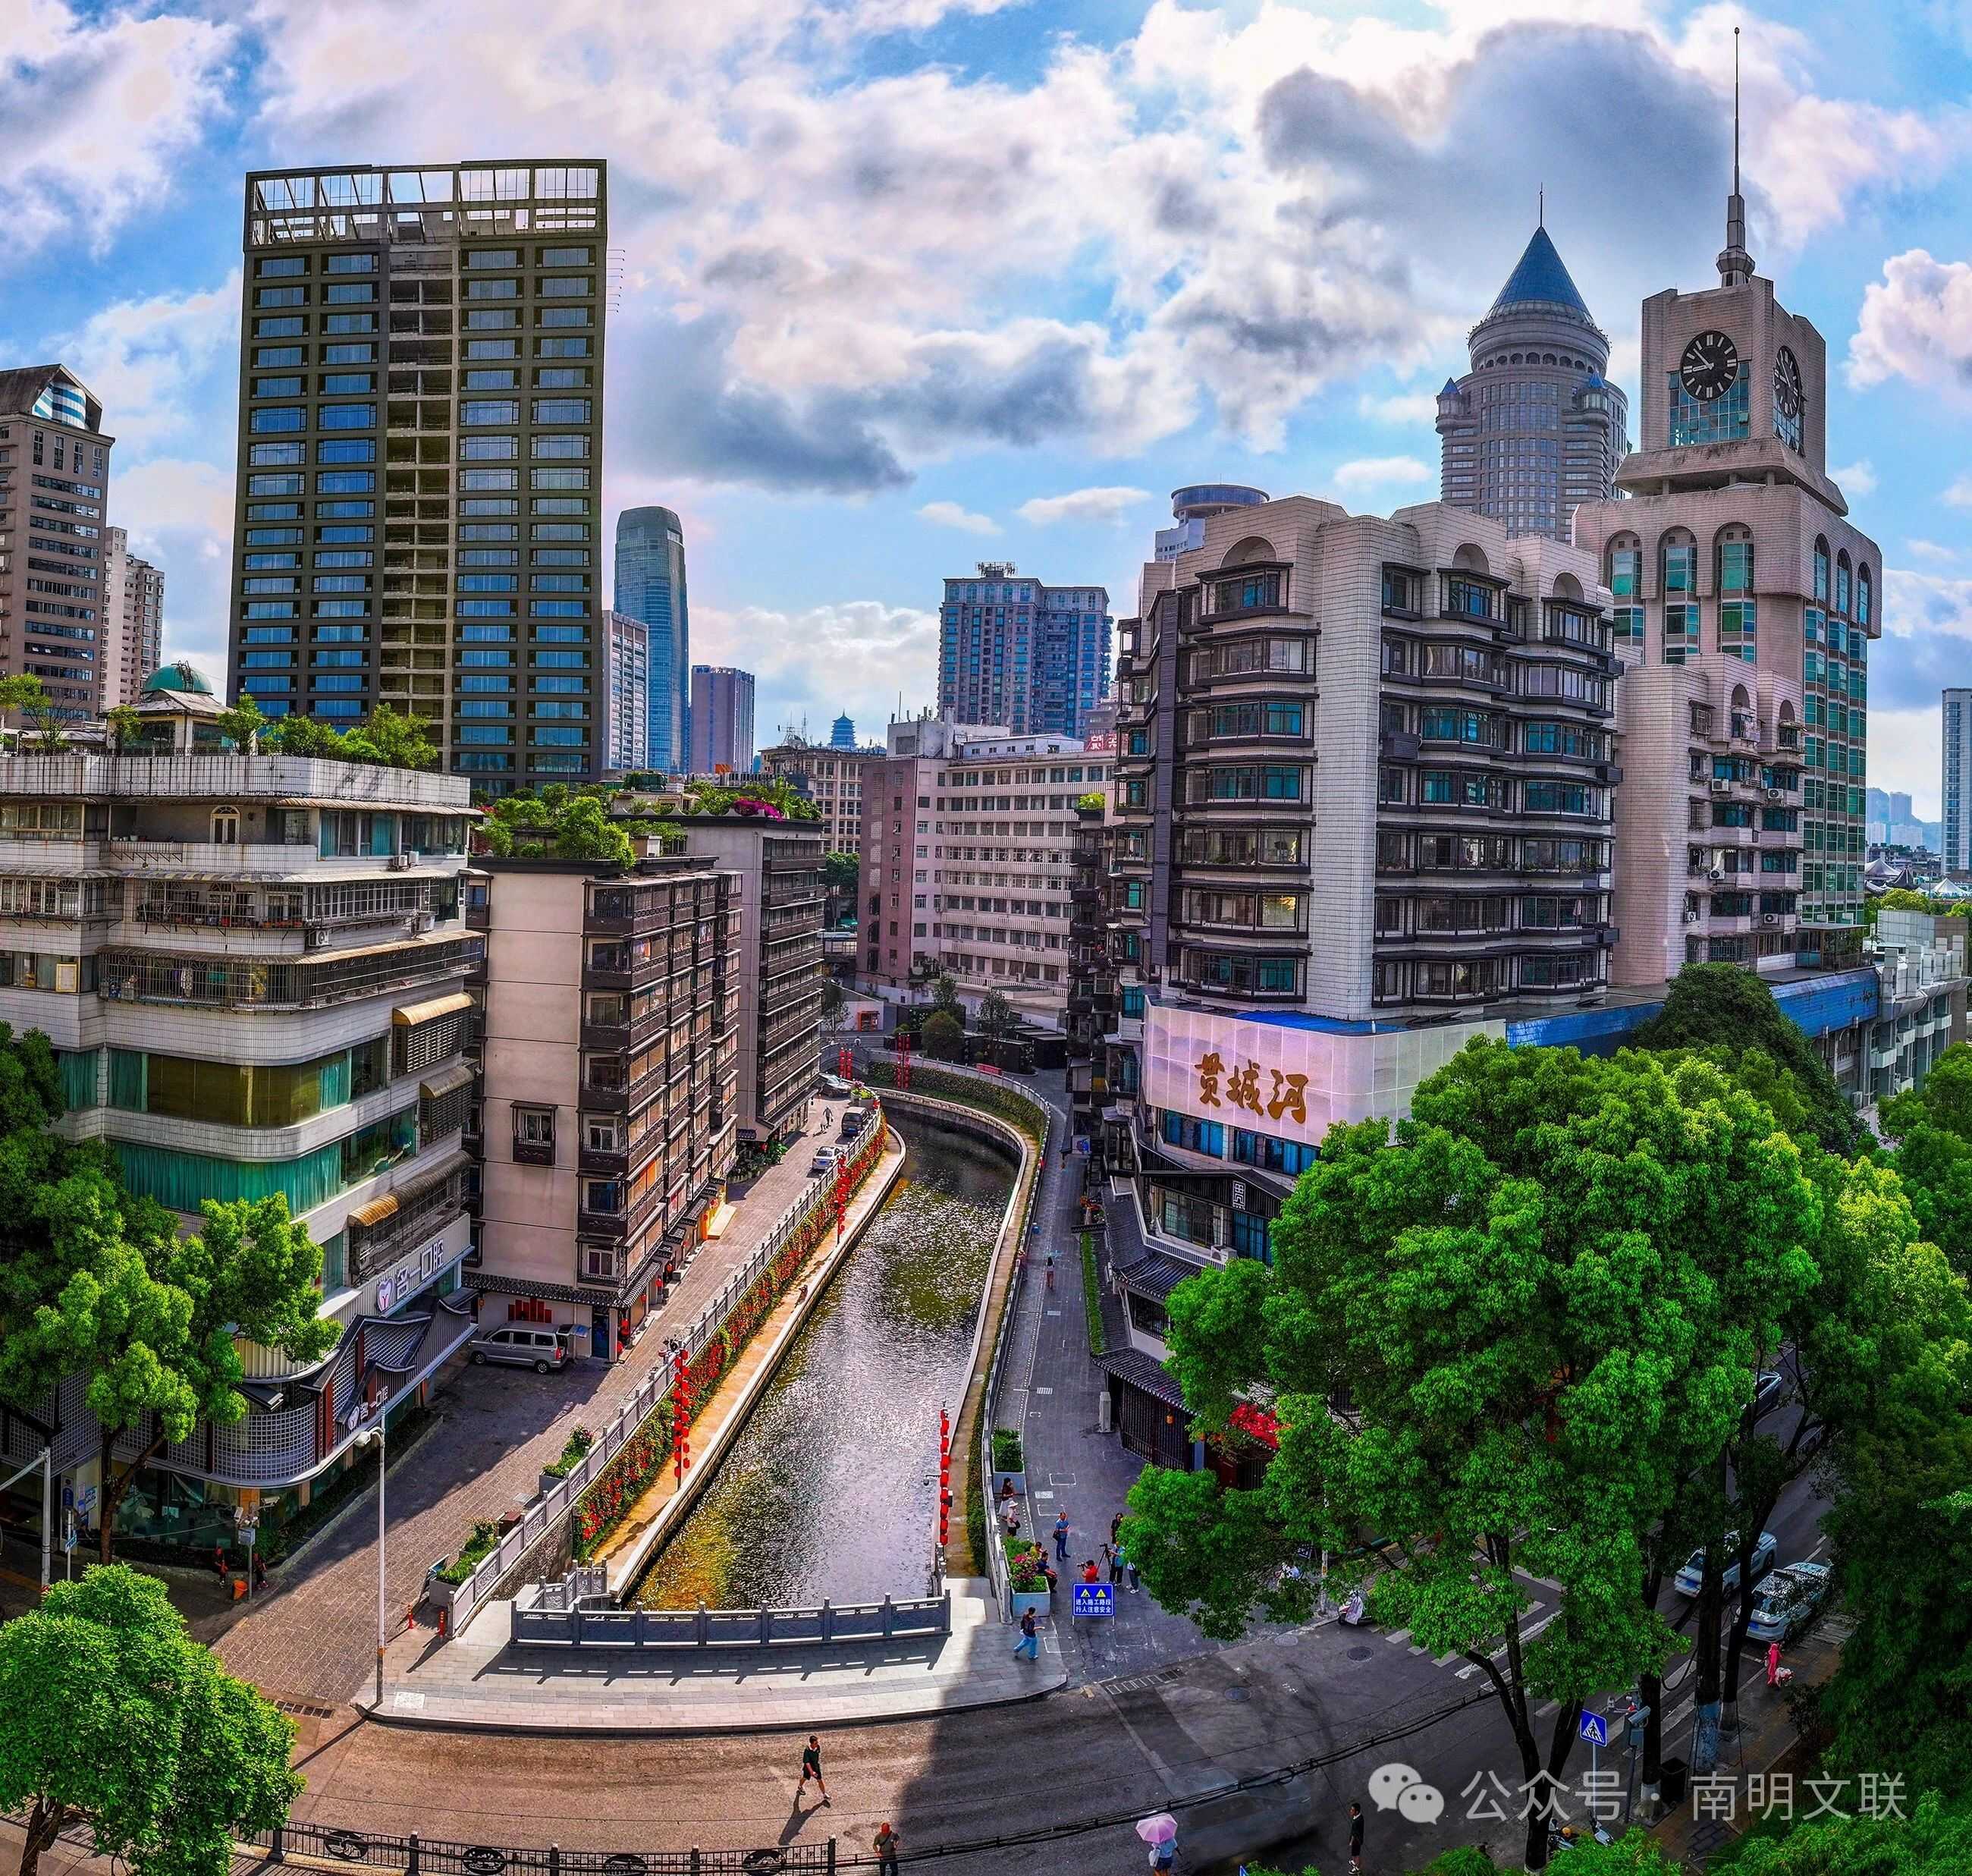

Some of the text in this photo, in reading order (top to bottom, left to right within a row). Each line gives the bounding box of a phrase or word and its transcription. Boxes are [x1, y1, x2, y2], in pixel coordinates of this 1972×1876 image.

[1195, 1052, 1309, 1124] 贯城河
[397, 1238, 444, 1300] 名一口腔
